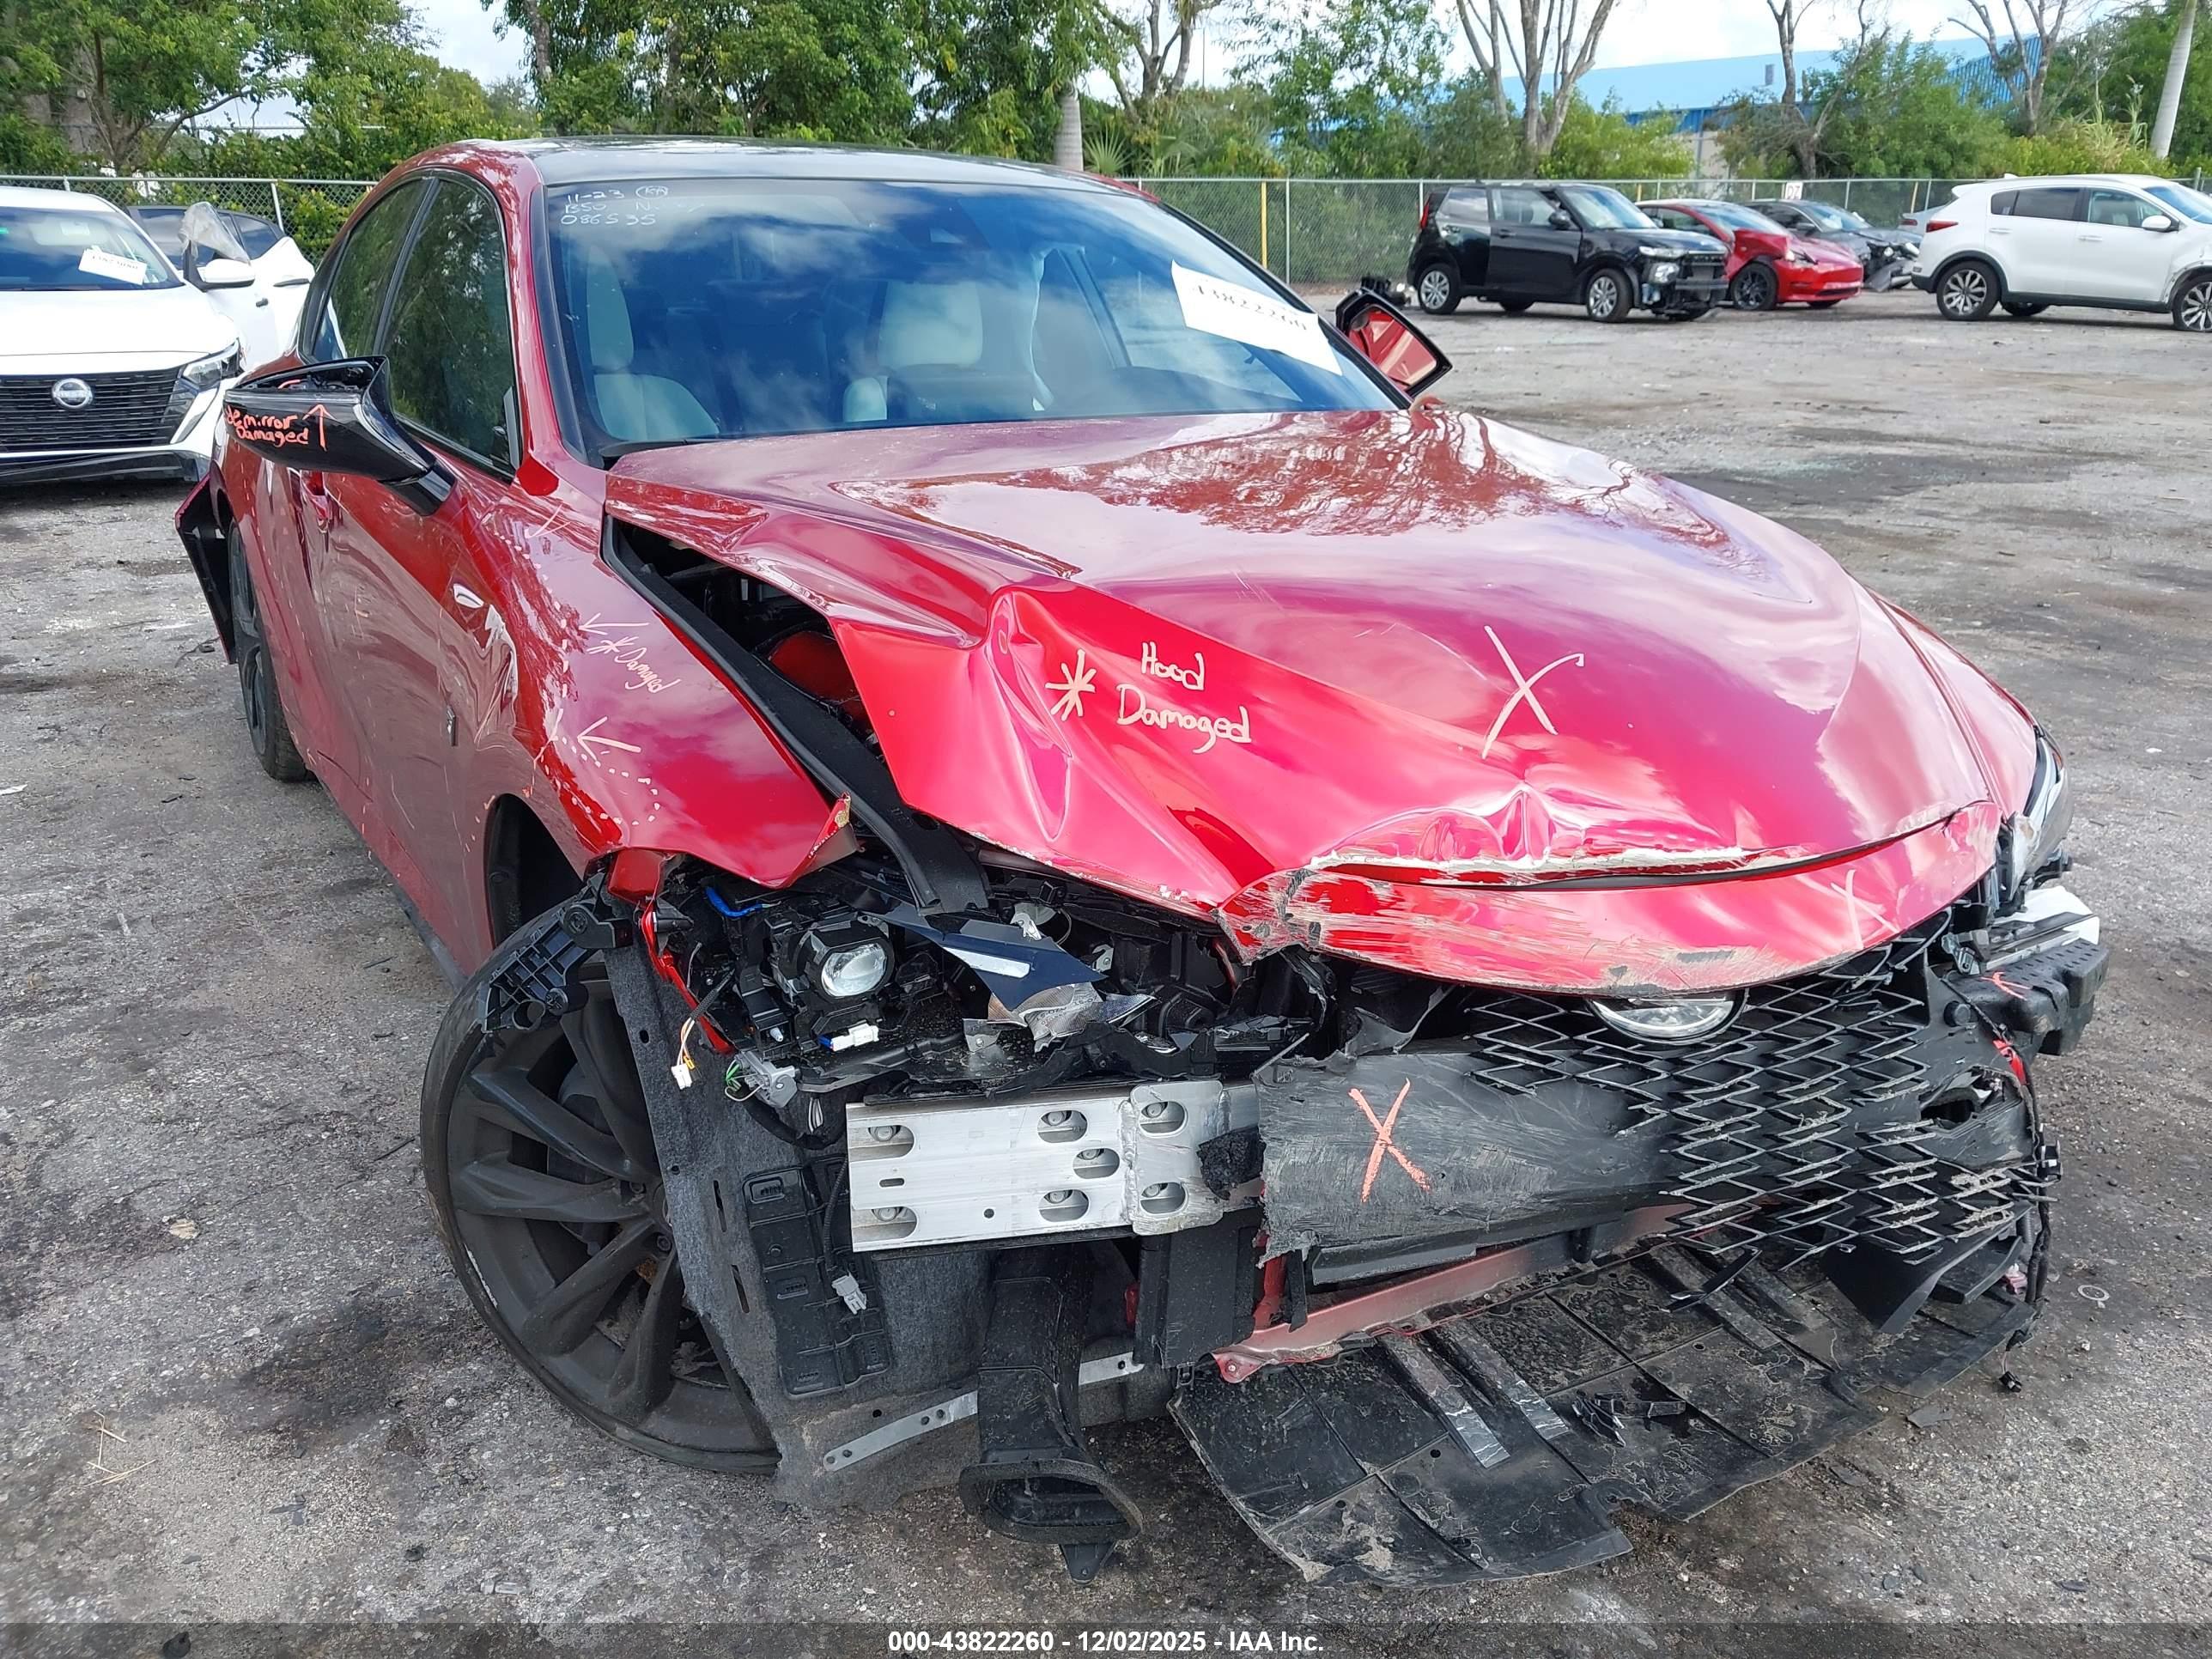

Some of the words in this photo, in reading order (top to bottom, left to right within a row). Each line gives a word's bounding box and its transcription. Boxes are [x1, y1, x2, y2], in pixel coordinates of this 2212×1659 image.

[236, 425, 309, 447] Damaged
[1140, 641, 1205, 690] Hood
[1115, 684, 1252, 754] Damaged
